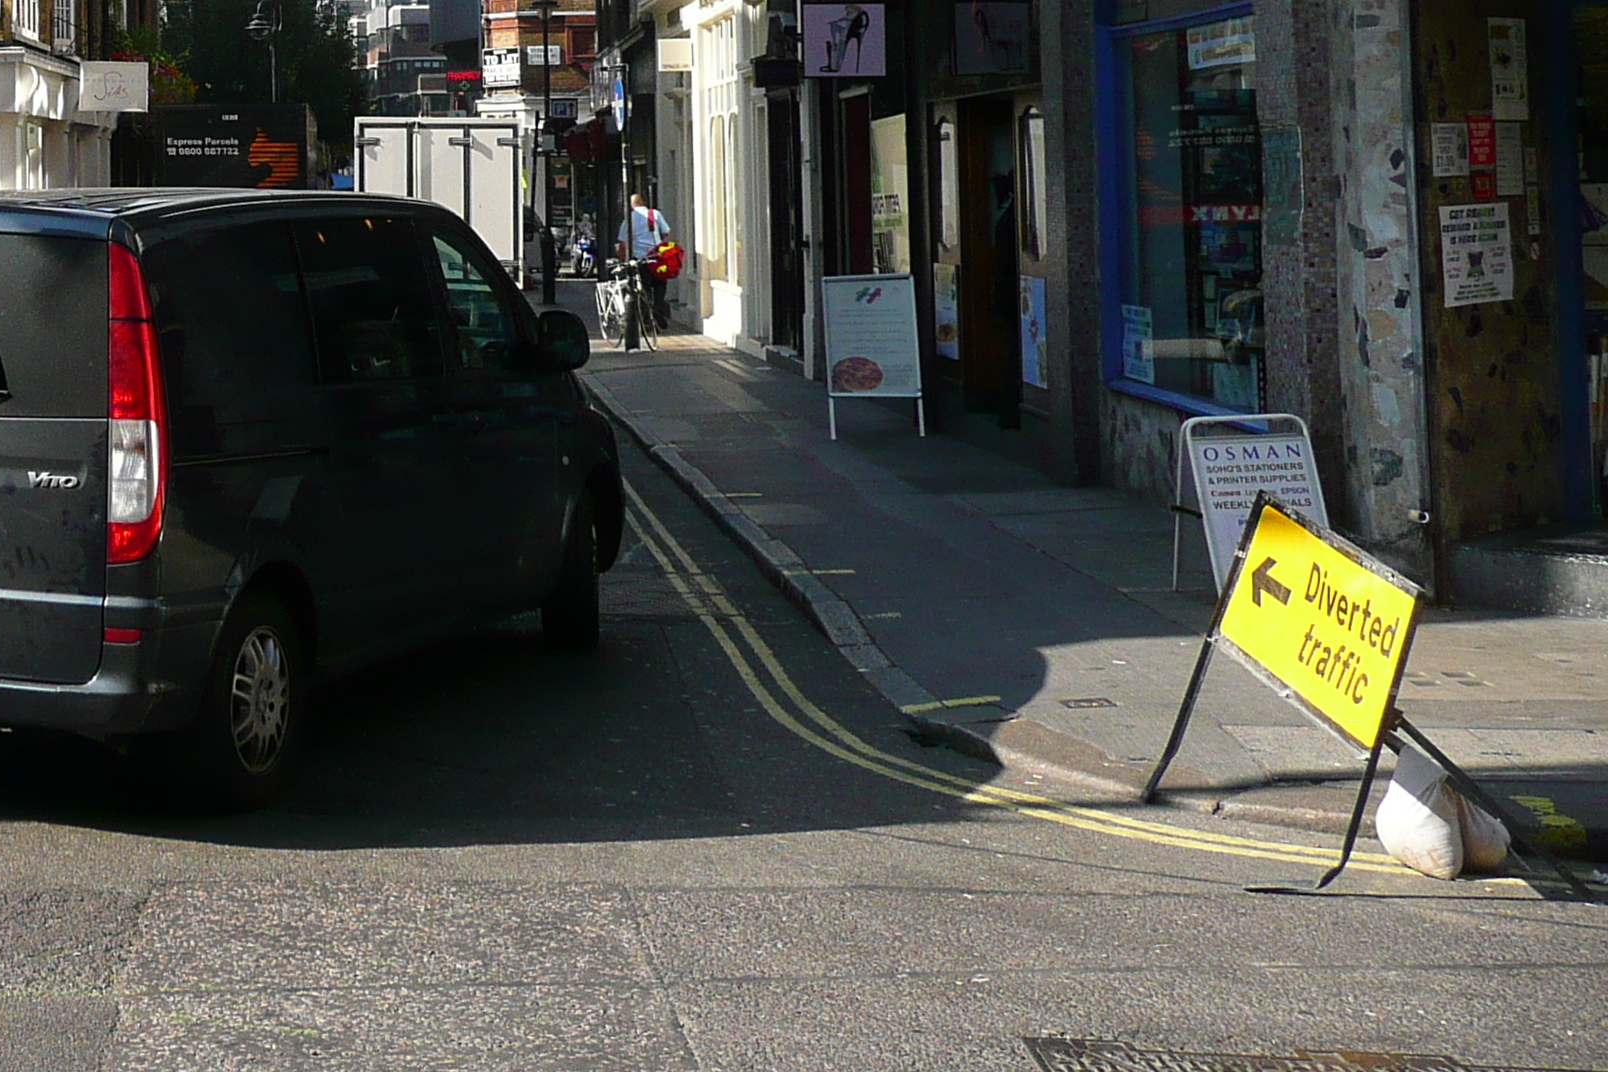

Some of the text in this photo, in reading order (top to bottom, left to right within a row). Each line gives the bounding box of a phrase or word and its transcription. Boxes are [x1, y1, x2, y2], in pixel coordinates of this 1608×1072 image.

[485, 55, 498, 65] TO
[501, 53, 518, 64] LET
[166, 136, 239, 146] Express Parcels
[1203, 443, 1302, 462] OSMAN
[1206, 461, 1304, 474] SOHO'S STATIONERS
[1216, 475, 1257, 485] PRINTER
[1259, 473, 1307, 484] SUPPLIES
[1304, 561, 1400, 659] Diverted
[1298, 624, 1368, 704] traffic
